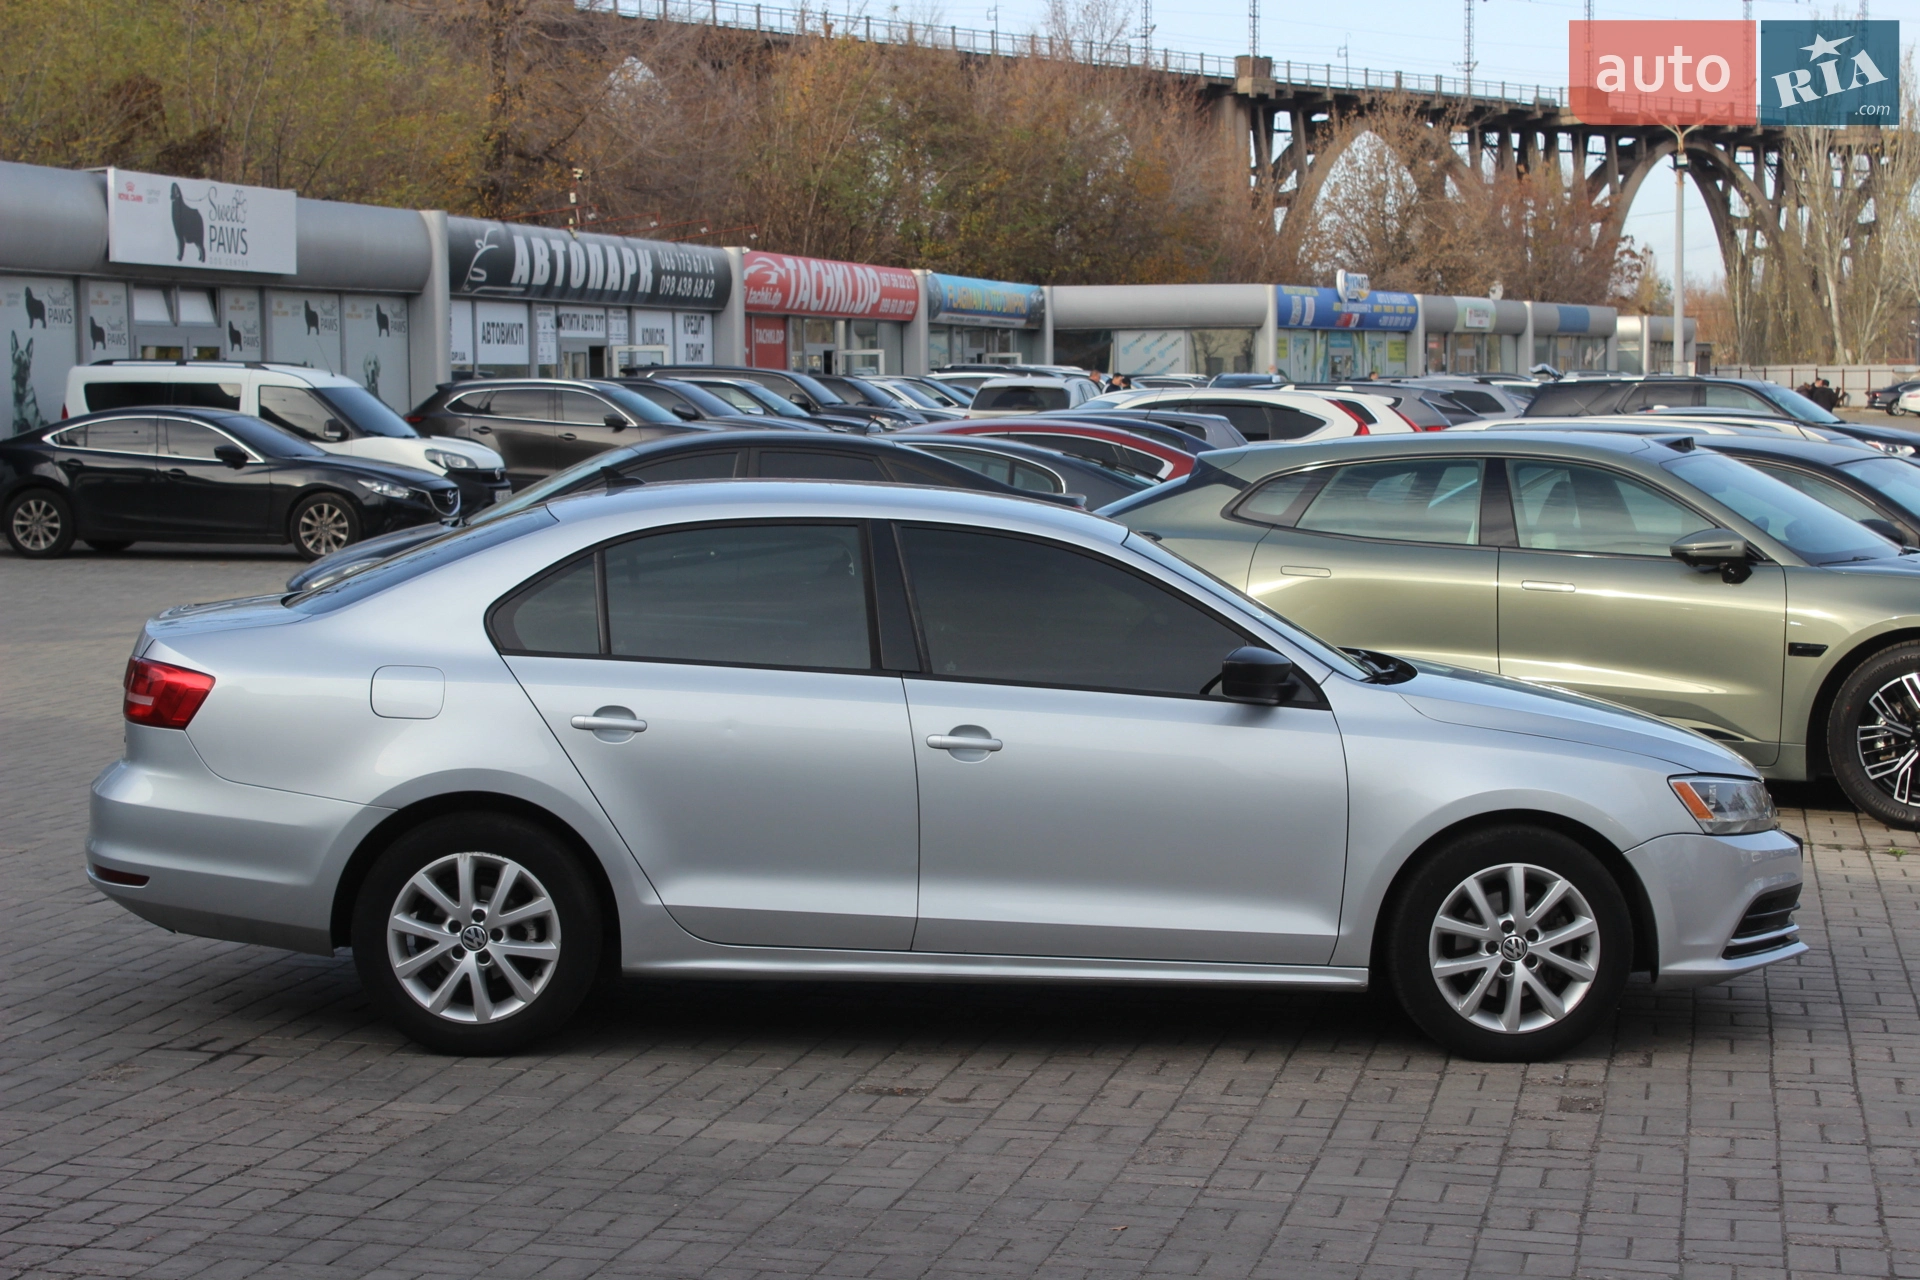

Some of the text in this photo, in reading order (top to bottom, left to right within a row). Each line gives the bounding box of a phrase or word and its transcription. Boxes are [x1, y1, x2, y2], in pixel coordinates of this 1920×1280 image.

[208, 186, 245, 223] Sweet
[209, 225, 248, 255] PAWS
[510, 235, 653, 293] АВТОПАРК
[658, 249, 714, 275] 066 175 67 14
[659, 274, 716, 299] 098 438 68 62
[782, 258, 881, 314] TACHKI.DP
[48, 308, 72, 324] PAWS
[107, 332, 126, 346] PAWS
[481, 321, 524, 345] АВТОВИКУП
